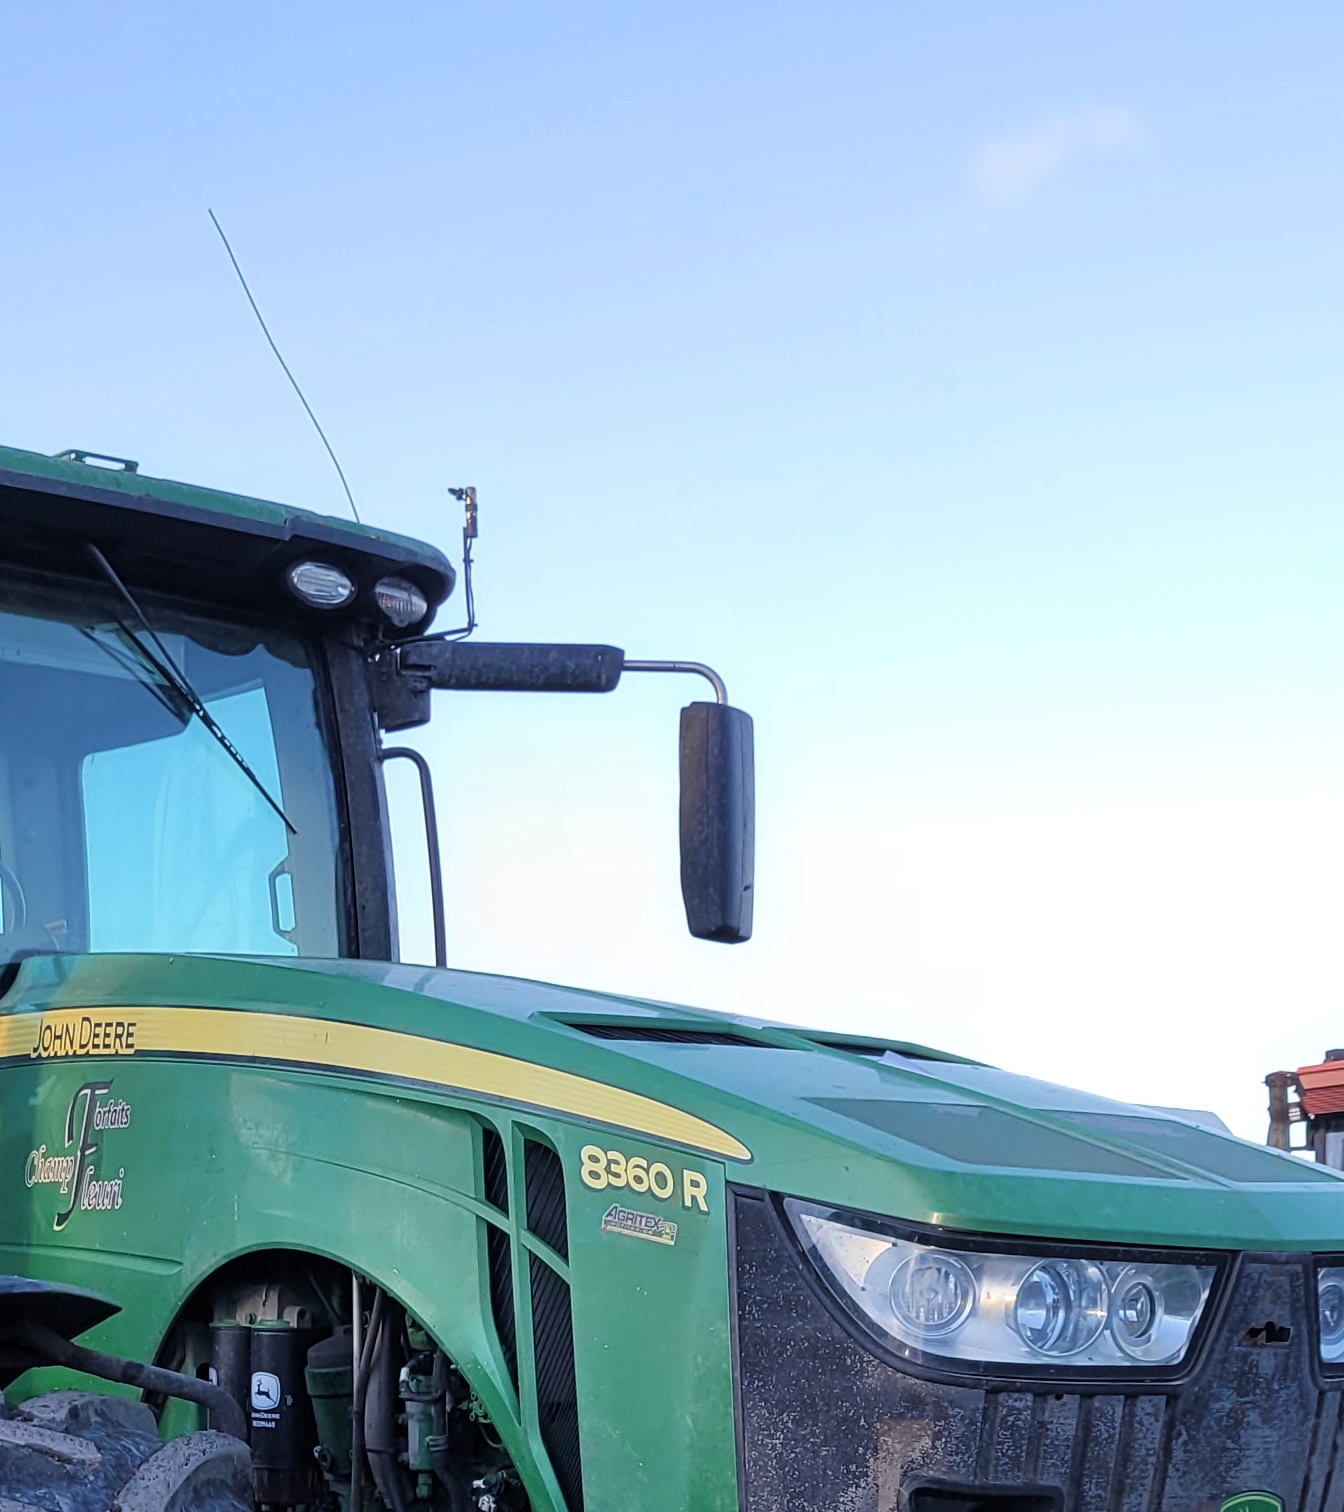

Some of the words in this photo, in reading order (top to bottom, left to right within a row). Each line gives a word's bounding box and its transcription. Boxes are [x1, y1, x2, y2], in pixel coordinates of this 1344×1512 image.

[32, 1018, 76, 1054] JOHN
[78, 1015, 137, 1051] DEERE
[25, 1145, 74, 1193] Champ
[579, 1144, 674, 1200] 8360
[682, 1168, 709, 1213] R
[604, 1205, 662, 1231] AGRITEX
